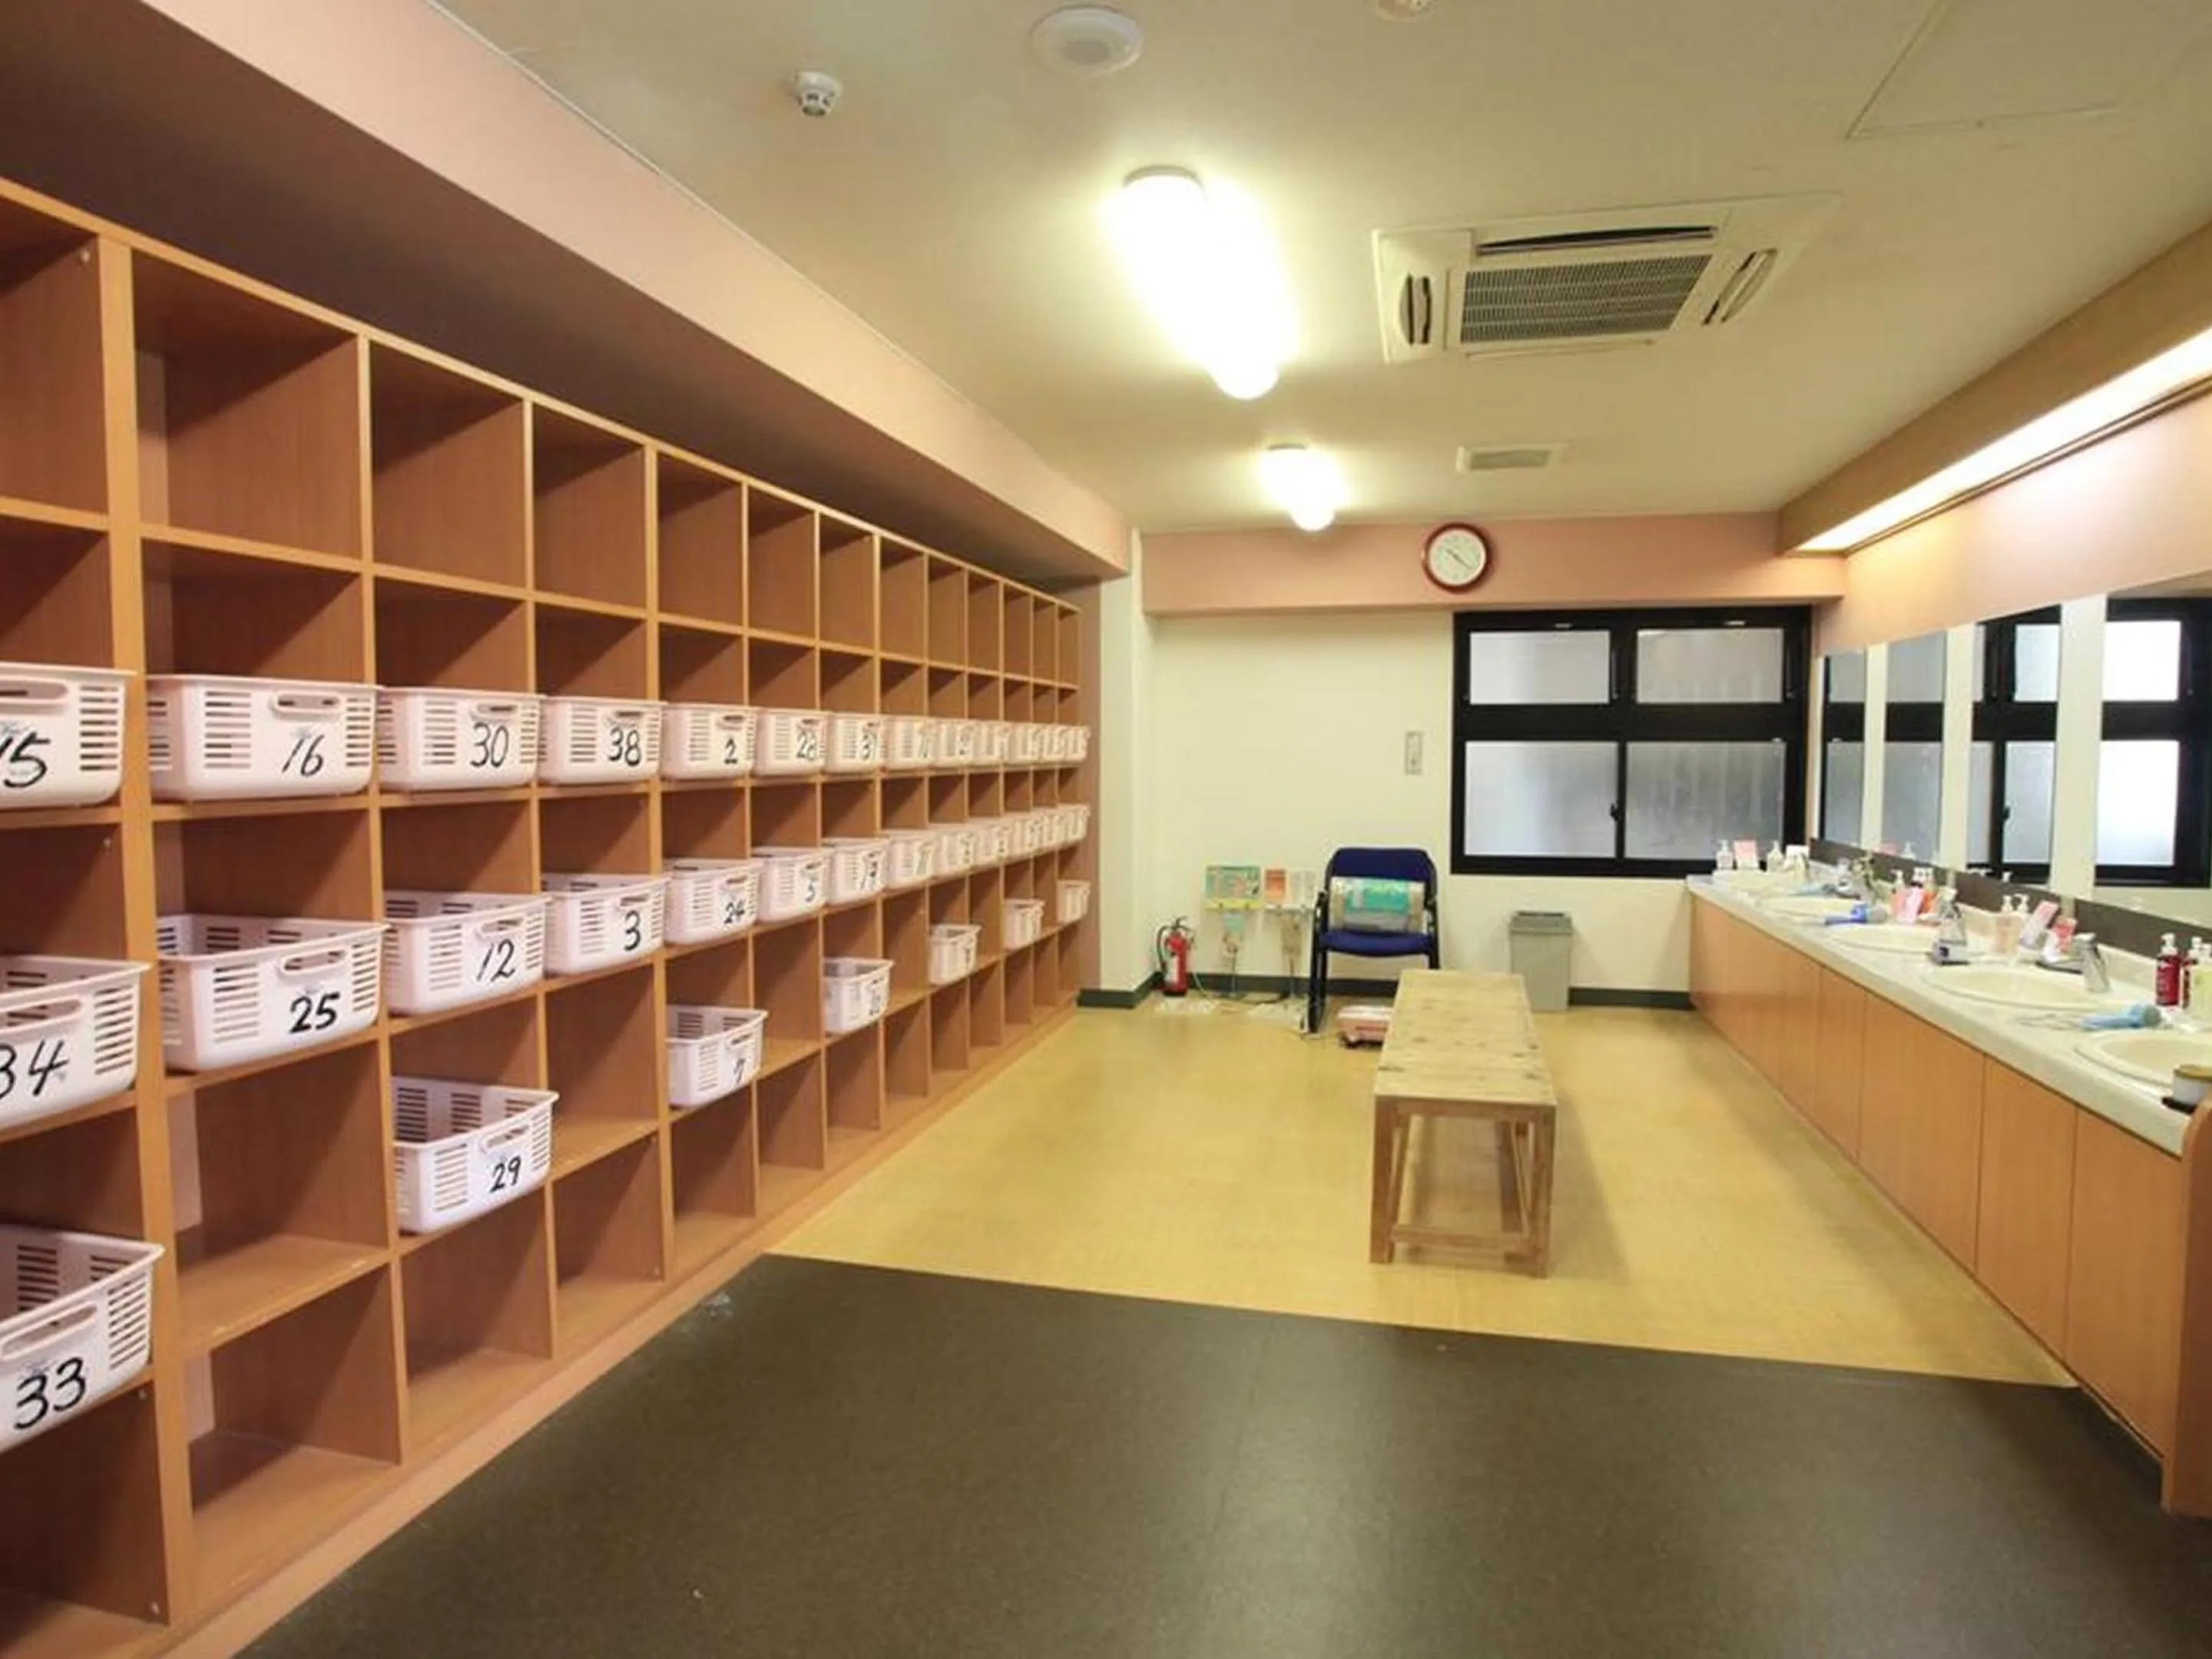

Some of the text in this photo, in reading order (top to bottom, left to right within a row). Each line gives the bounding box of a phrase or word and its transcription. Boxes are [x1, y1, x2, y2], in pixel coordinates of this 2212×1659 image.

[281, 733, 325, 777] 16
[470, 722, 510, 768] 30
[608, 727, 642, 767] 38
[724, 737, 738, 765] 2
[624, 909, 641, 952] 3
[476, 938, 516, 982] 12
[290, 992, 340, 1034] 25
[489, 1155, 522, 1194] 29
[14, 1356, 87, 1430] 33
